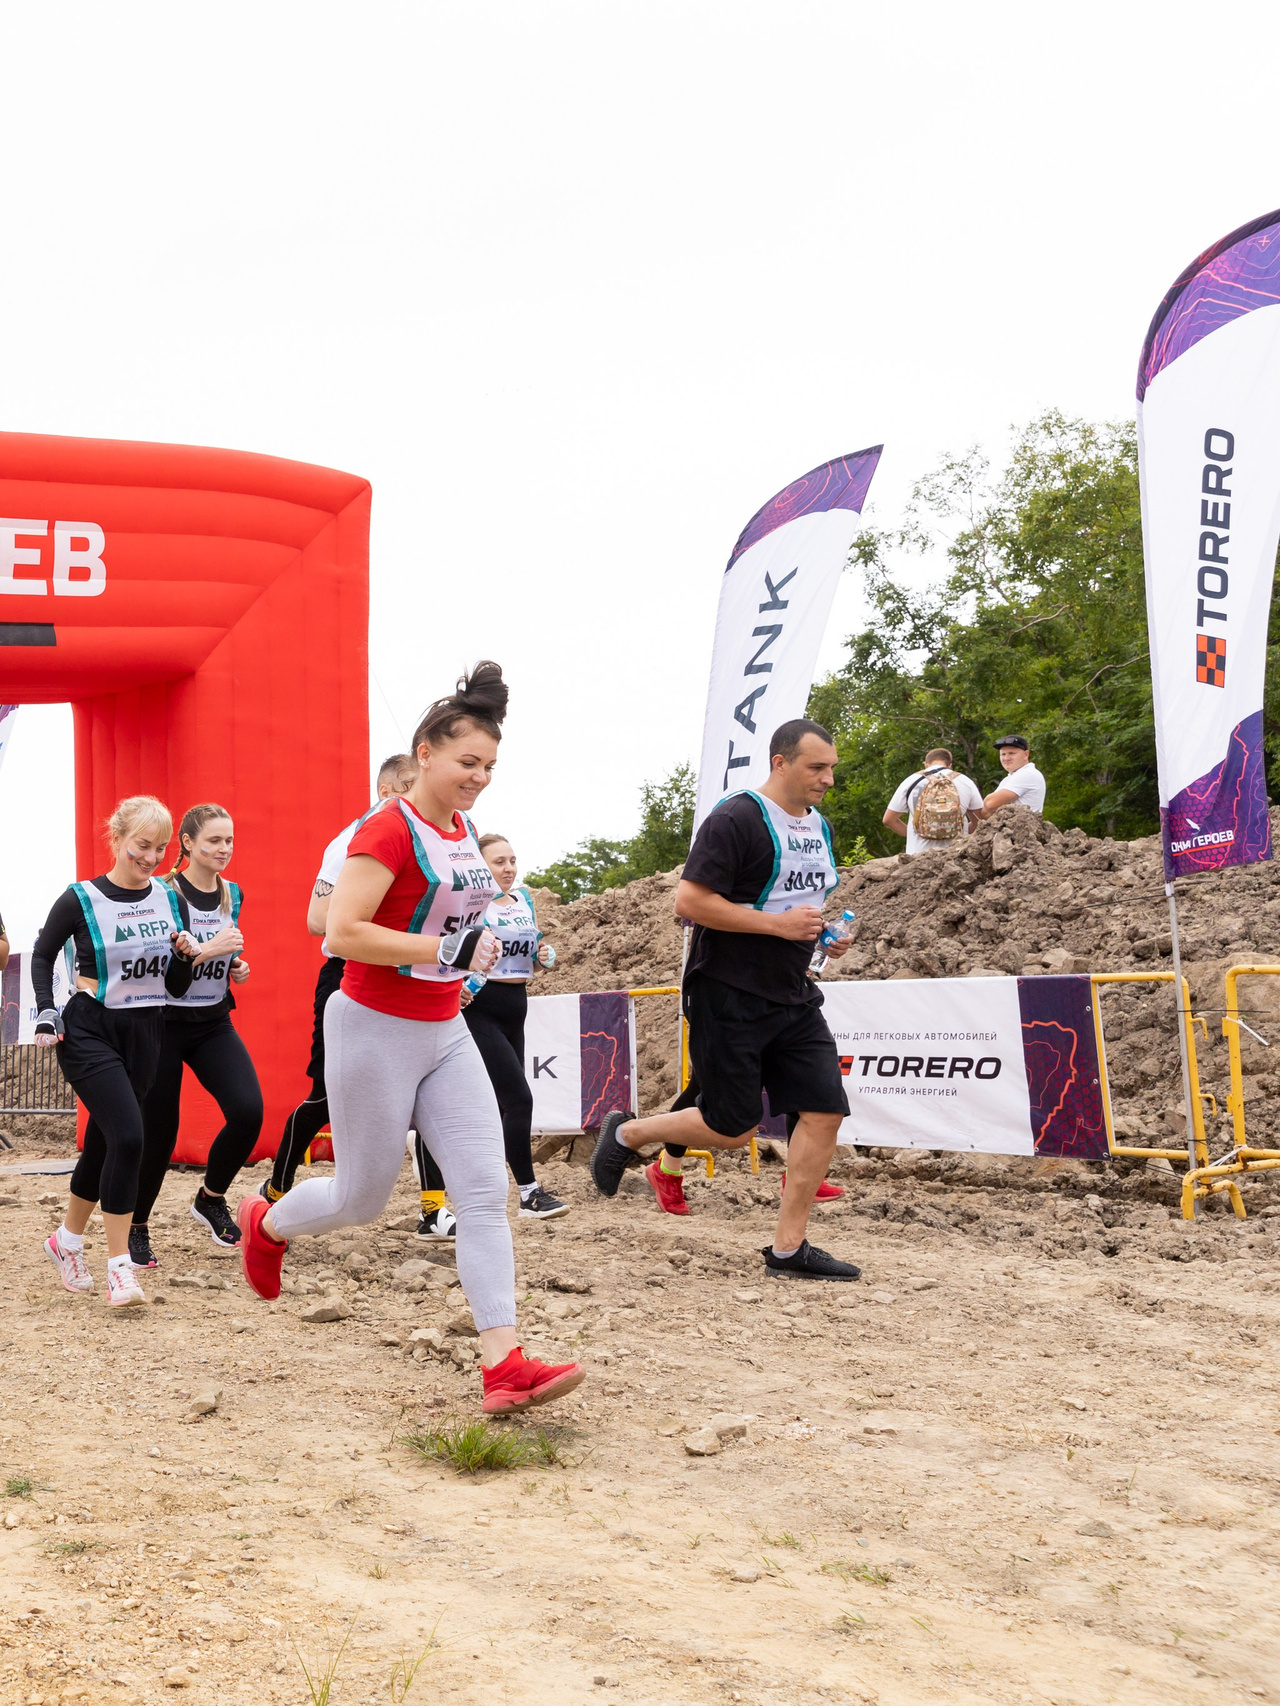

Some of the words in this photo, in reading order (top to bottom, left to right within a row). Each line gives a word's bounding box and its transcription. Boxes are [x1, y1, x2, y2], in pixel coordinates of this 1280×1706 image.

[1196, 427, 1235, 628] TORERO
[723, 566, 798, 791] TANK
[802, 838, 822, 854] RFP
[1192, 830, 1234, 847] ГЕРОЕВ
[468, 868, 492, 889] RFP
[784, 870, 825, 891] 5047
[138, 920, 169, 939] RFP
[144, 945, 164, 953] products
[853, 1033, 871, 1041] ДЛЯ
[873, 1032, 921, 1041] ЛЕГКОВЫХ
[924, 1031, 998, 1041] АВТОМОБИЛЕЙ
[858, 1055, 1002, 1080] TORERO
[858, 1086, 907, 1095] УПРАВЛЯЙ
[910, 1087, 958, 1096] ЭНЕРГИЕЙ
